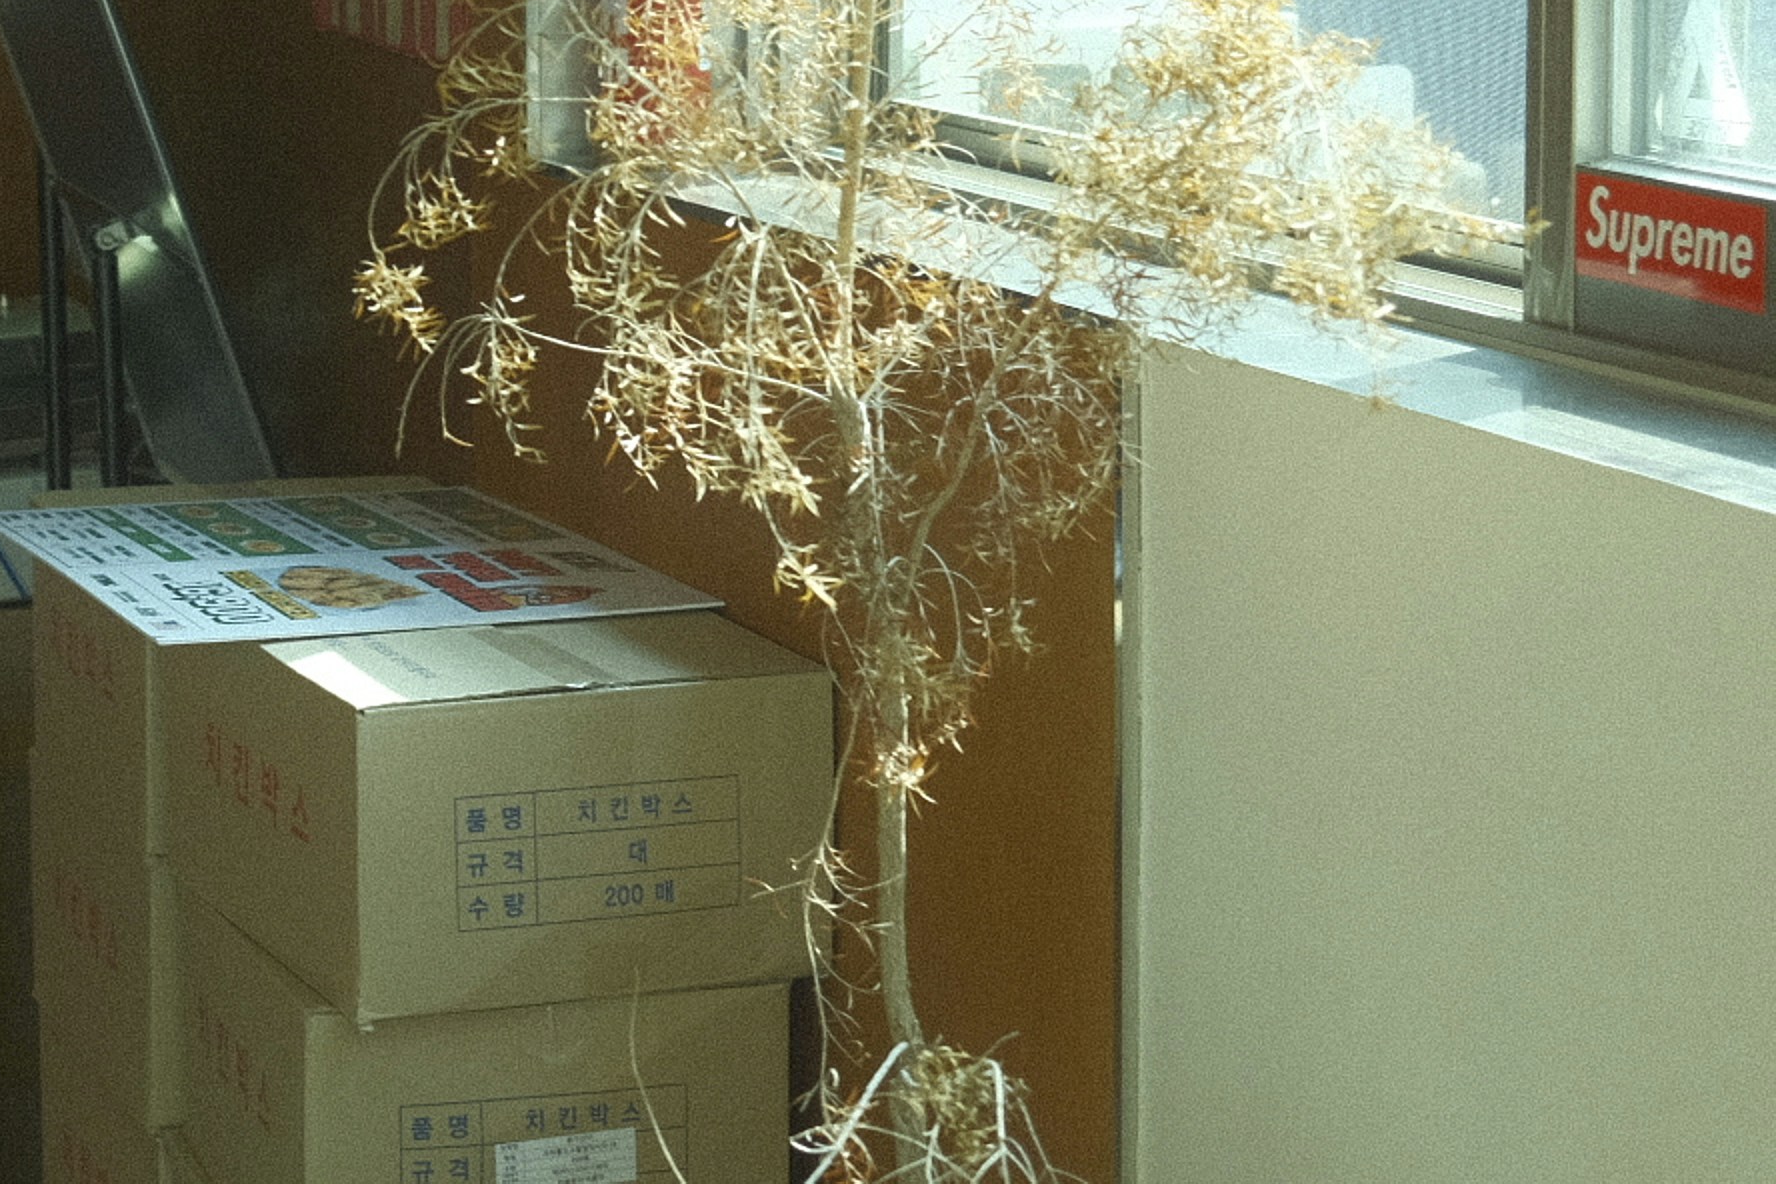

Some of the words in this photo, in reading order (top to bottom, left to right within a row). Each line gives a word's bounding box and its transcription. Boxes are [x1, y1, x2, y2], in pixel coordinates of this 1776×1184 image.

[1585, 184, 1754, 280] Supreme
[205, 721, 313, 844] 치킨박스
[578, 792, 693, 824] 치킨박스
[628, 838, 649, 865] 대
[604, 883, 645, 908] 200
